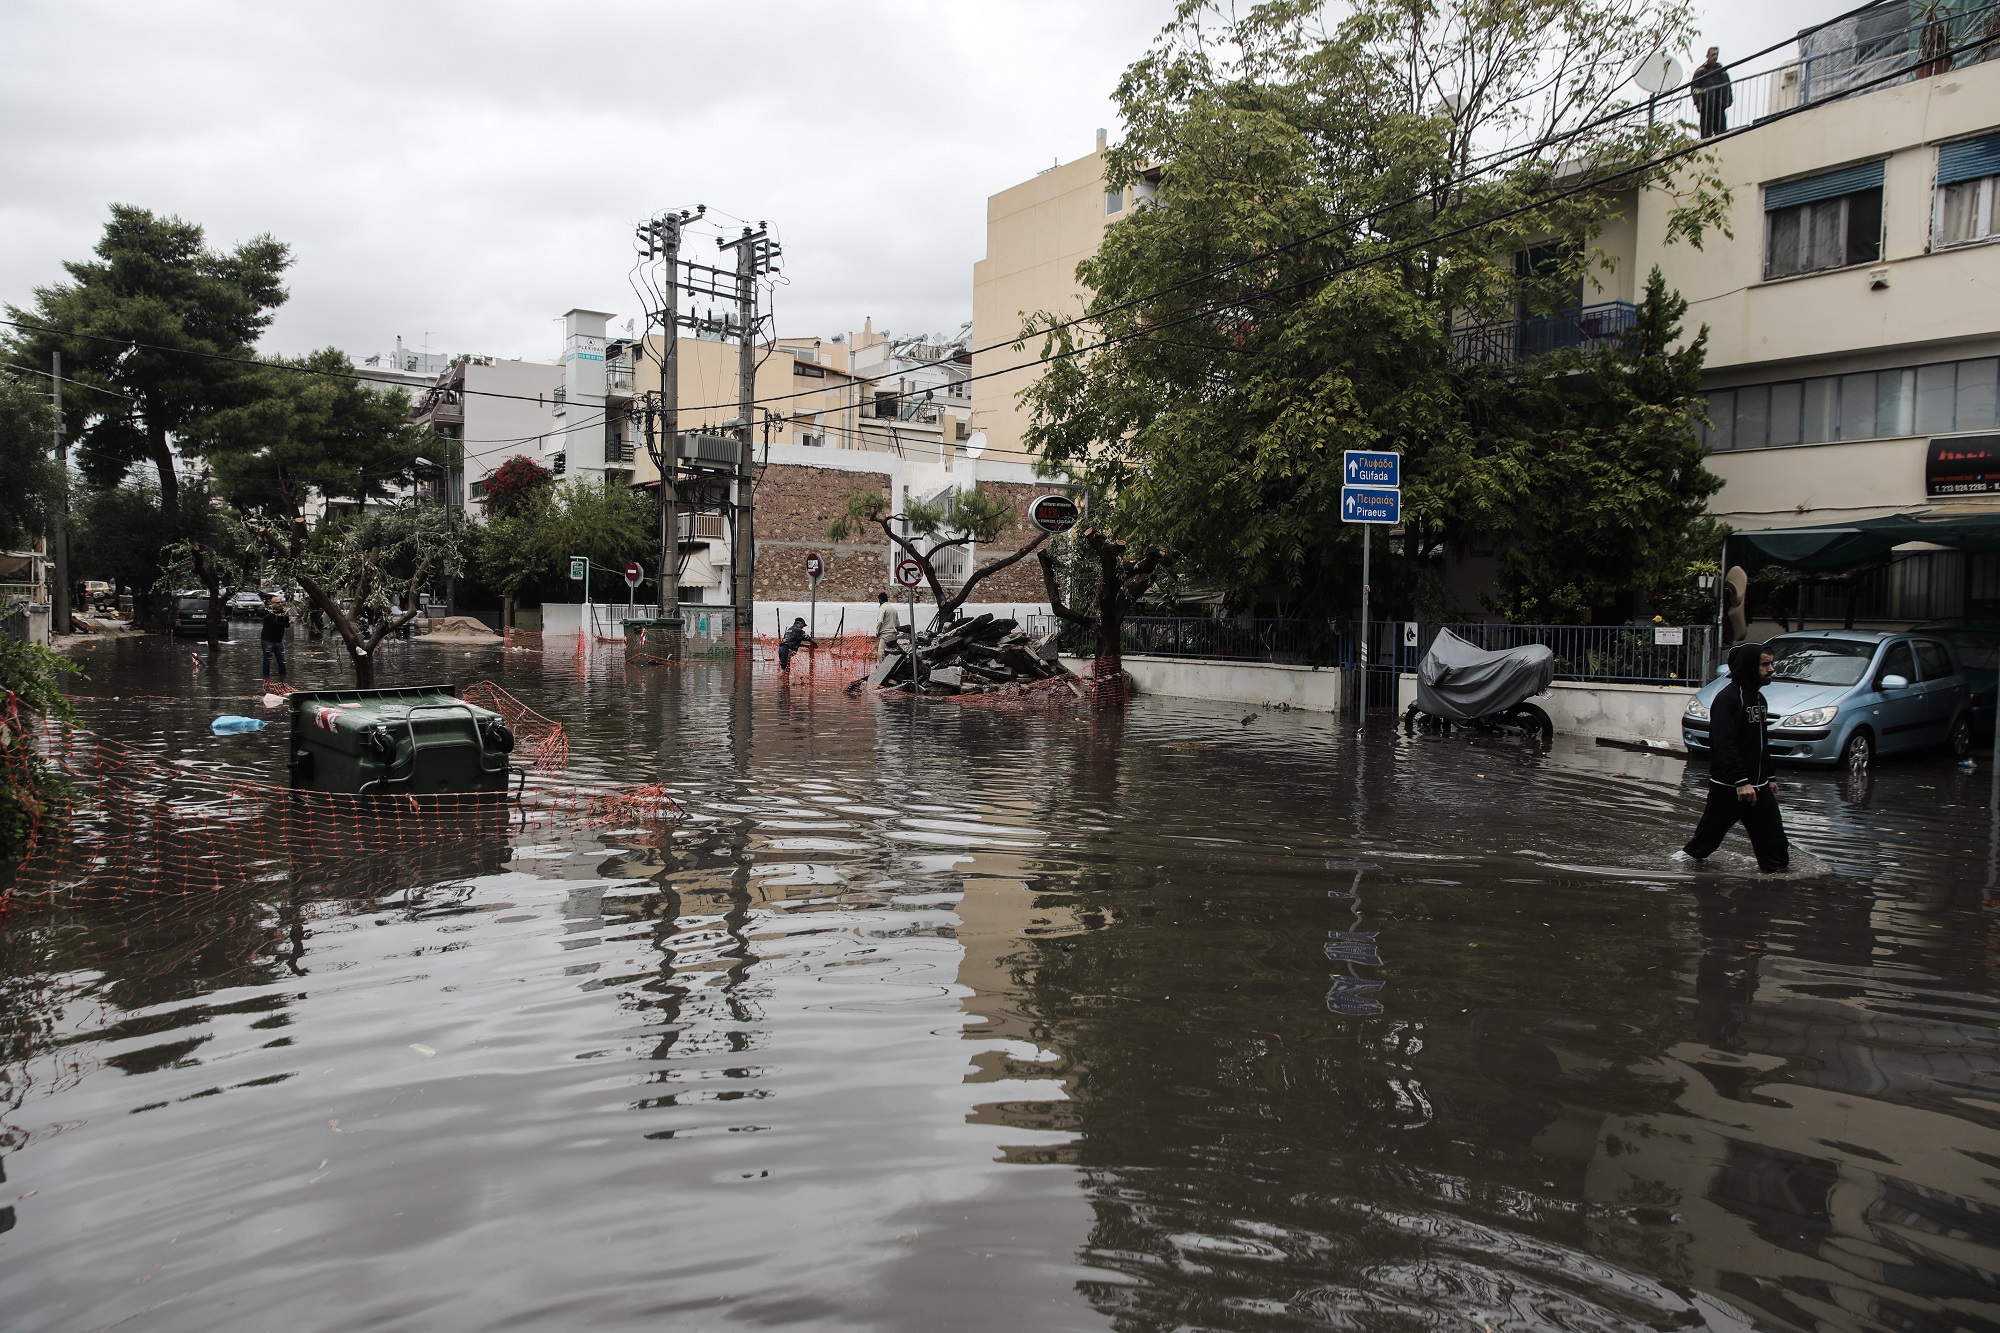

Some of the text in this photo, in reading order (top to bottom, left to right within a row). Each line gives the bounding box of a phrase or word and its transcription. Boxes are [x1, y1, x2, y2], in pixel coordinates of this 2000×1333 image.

[1359, 457, 1393, 470] Γλυφάδα
[1359, 470, 1389, 481] Glifada
[1357, 493, 1394, 506] Πειραιάς
[1356, 506, 1387, 517] Piraeus
